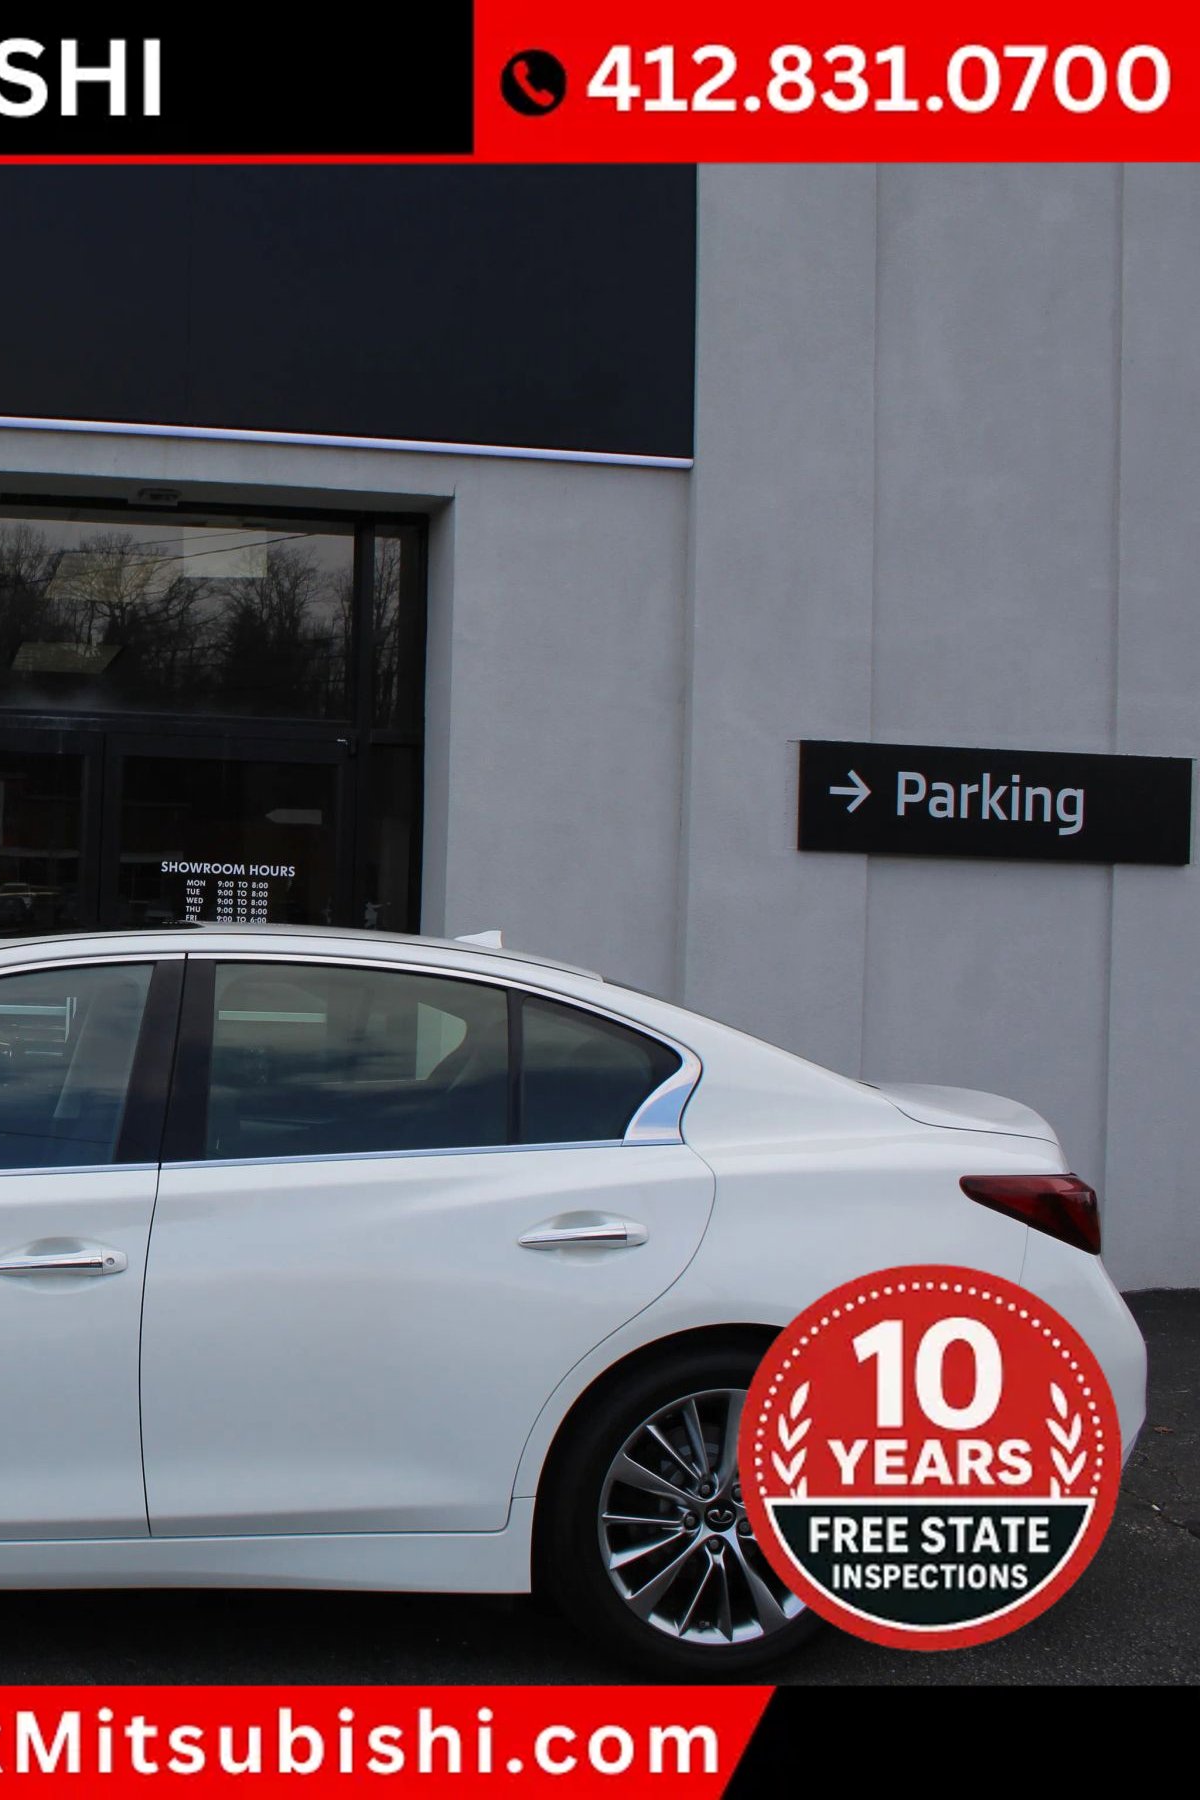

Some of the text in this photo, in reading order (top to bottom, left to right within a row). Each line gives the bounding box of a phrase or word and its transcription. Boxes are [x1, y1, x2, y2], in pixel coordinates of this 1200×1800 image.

[897, 771, 1085, 836] Parking
[161, 861, 296, 877] SHOWROOM HOURS
[185, 905, 201, 913] THU
